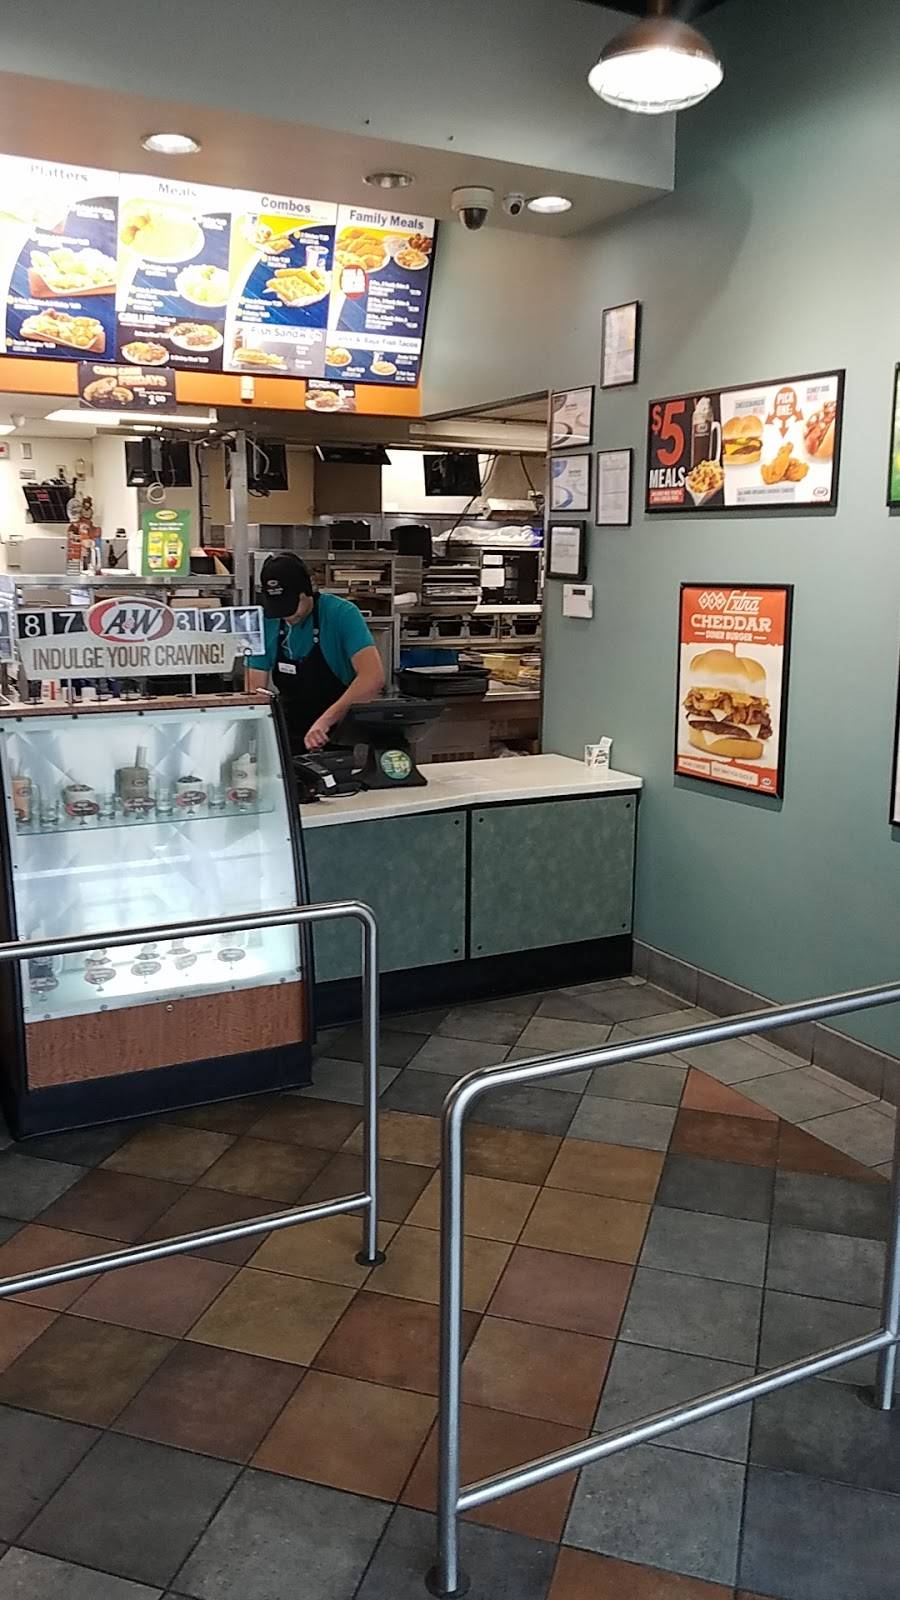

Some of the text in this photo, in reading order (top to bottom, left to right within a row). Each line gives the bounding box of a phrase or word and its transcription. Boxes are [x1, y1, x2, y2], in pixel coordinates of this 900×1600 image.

[158, 183, 197, 197] Meals
[261, 196, 311, 214] Combos
[350, 209, 425, 230] Family Meals
[651, 402, 686, 466] $5
[649, 466, 685, 488] MEALS
[723, 590, 763, 615] Extra
[24, 612, 77, 638] 8 7
[103, 609, 163, 635] A&W
[176, 611, 251, 633] 3 2 1
[691, 614, 772, 632] CHEDDAR
[33, 643, 225, 671] INDULGE YOUR CRAVING!
